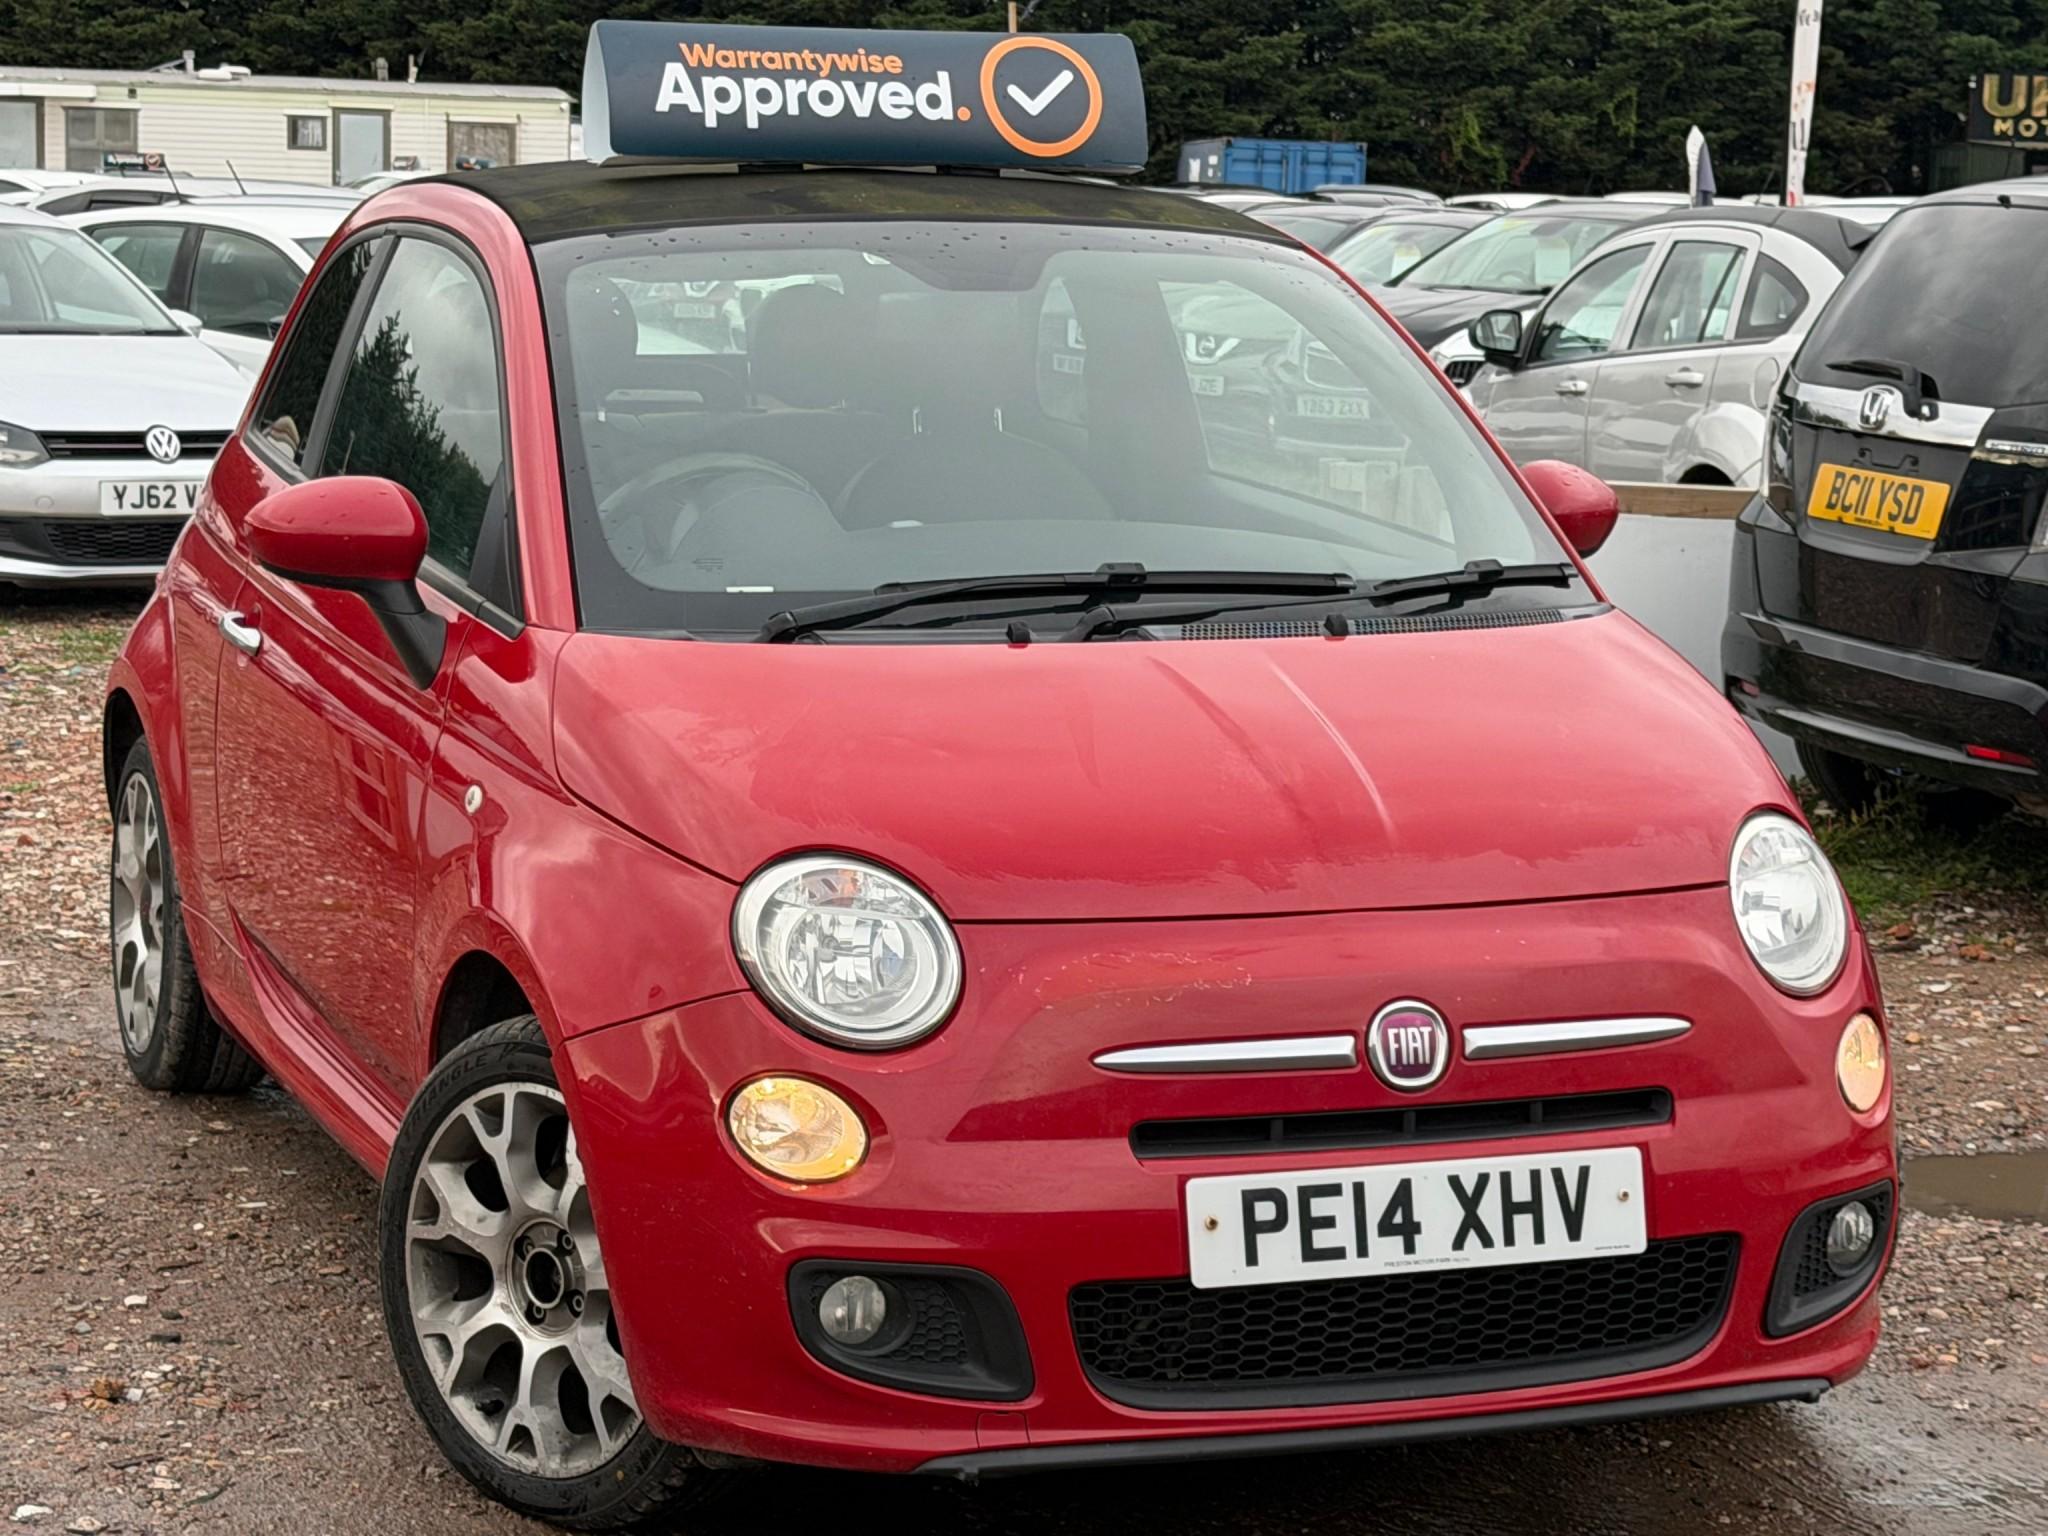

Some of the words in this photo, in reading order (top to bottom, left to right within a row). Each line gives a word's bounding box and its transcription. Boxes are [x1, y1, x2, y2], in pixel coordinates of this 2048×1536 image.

[679, 43, 903, 77] Warrantywise
[655, 62, 972, 129] Approved.
[113, 484, 177, 510] YJ62
[183, 484, 203, 510] V
[1825, 470, 1875, 516] BC11
[1875, 478, 1925, 525] YSD
[1387, 1026, 1433, 1066] FIAT
[1240, 1177, 1423, 1268] PE14
[1446, 1164, 1592, 1252] XHV
